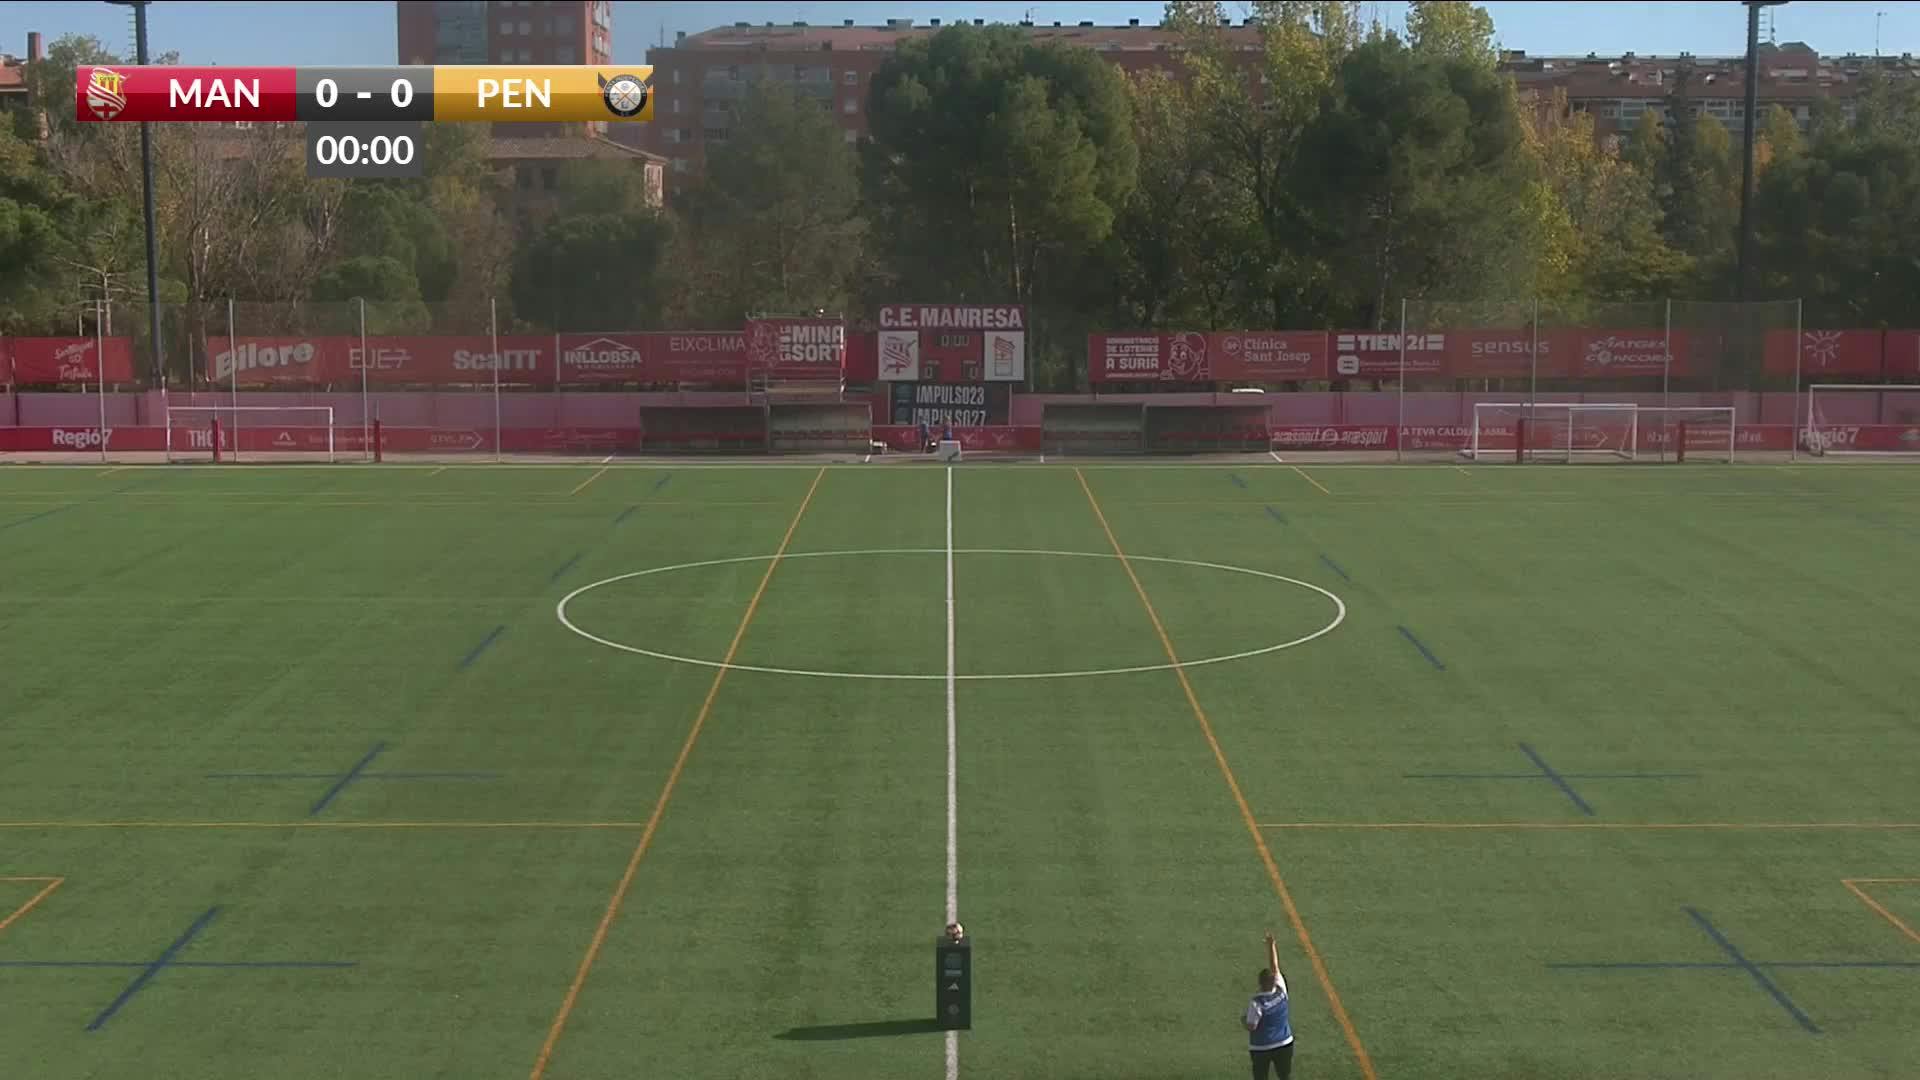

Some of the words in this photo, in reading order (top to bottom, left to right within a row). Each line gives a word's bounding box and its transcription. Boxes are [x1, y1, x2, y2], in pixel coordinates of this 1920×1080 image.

[880, 307, 919, 328] C.E.
[921, 307, 1024, 328] MANRESA
[670, 336, 747, 352] EIXCLIMA
[1358, 335, 1402, 351] TIEN
[1406, 335, 1425, 351] 21
[1471, 340, 1550, 353] sensus
[916, 385, 985, 405] IMPULSO23
